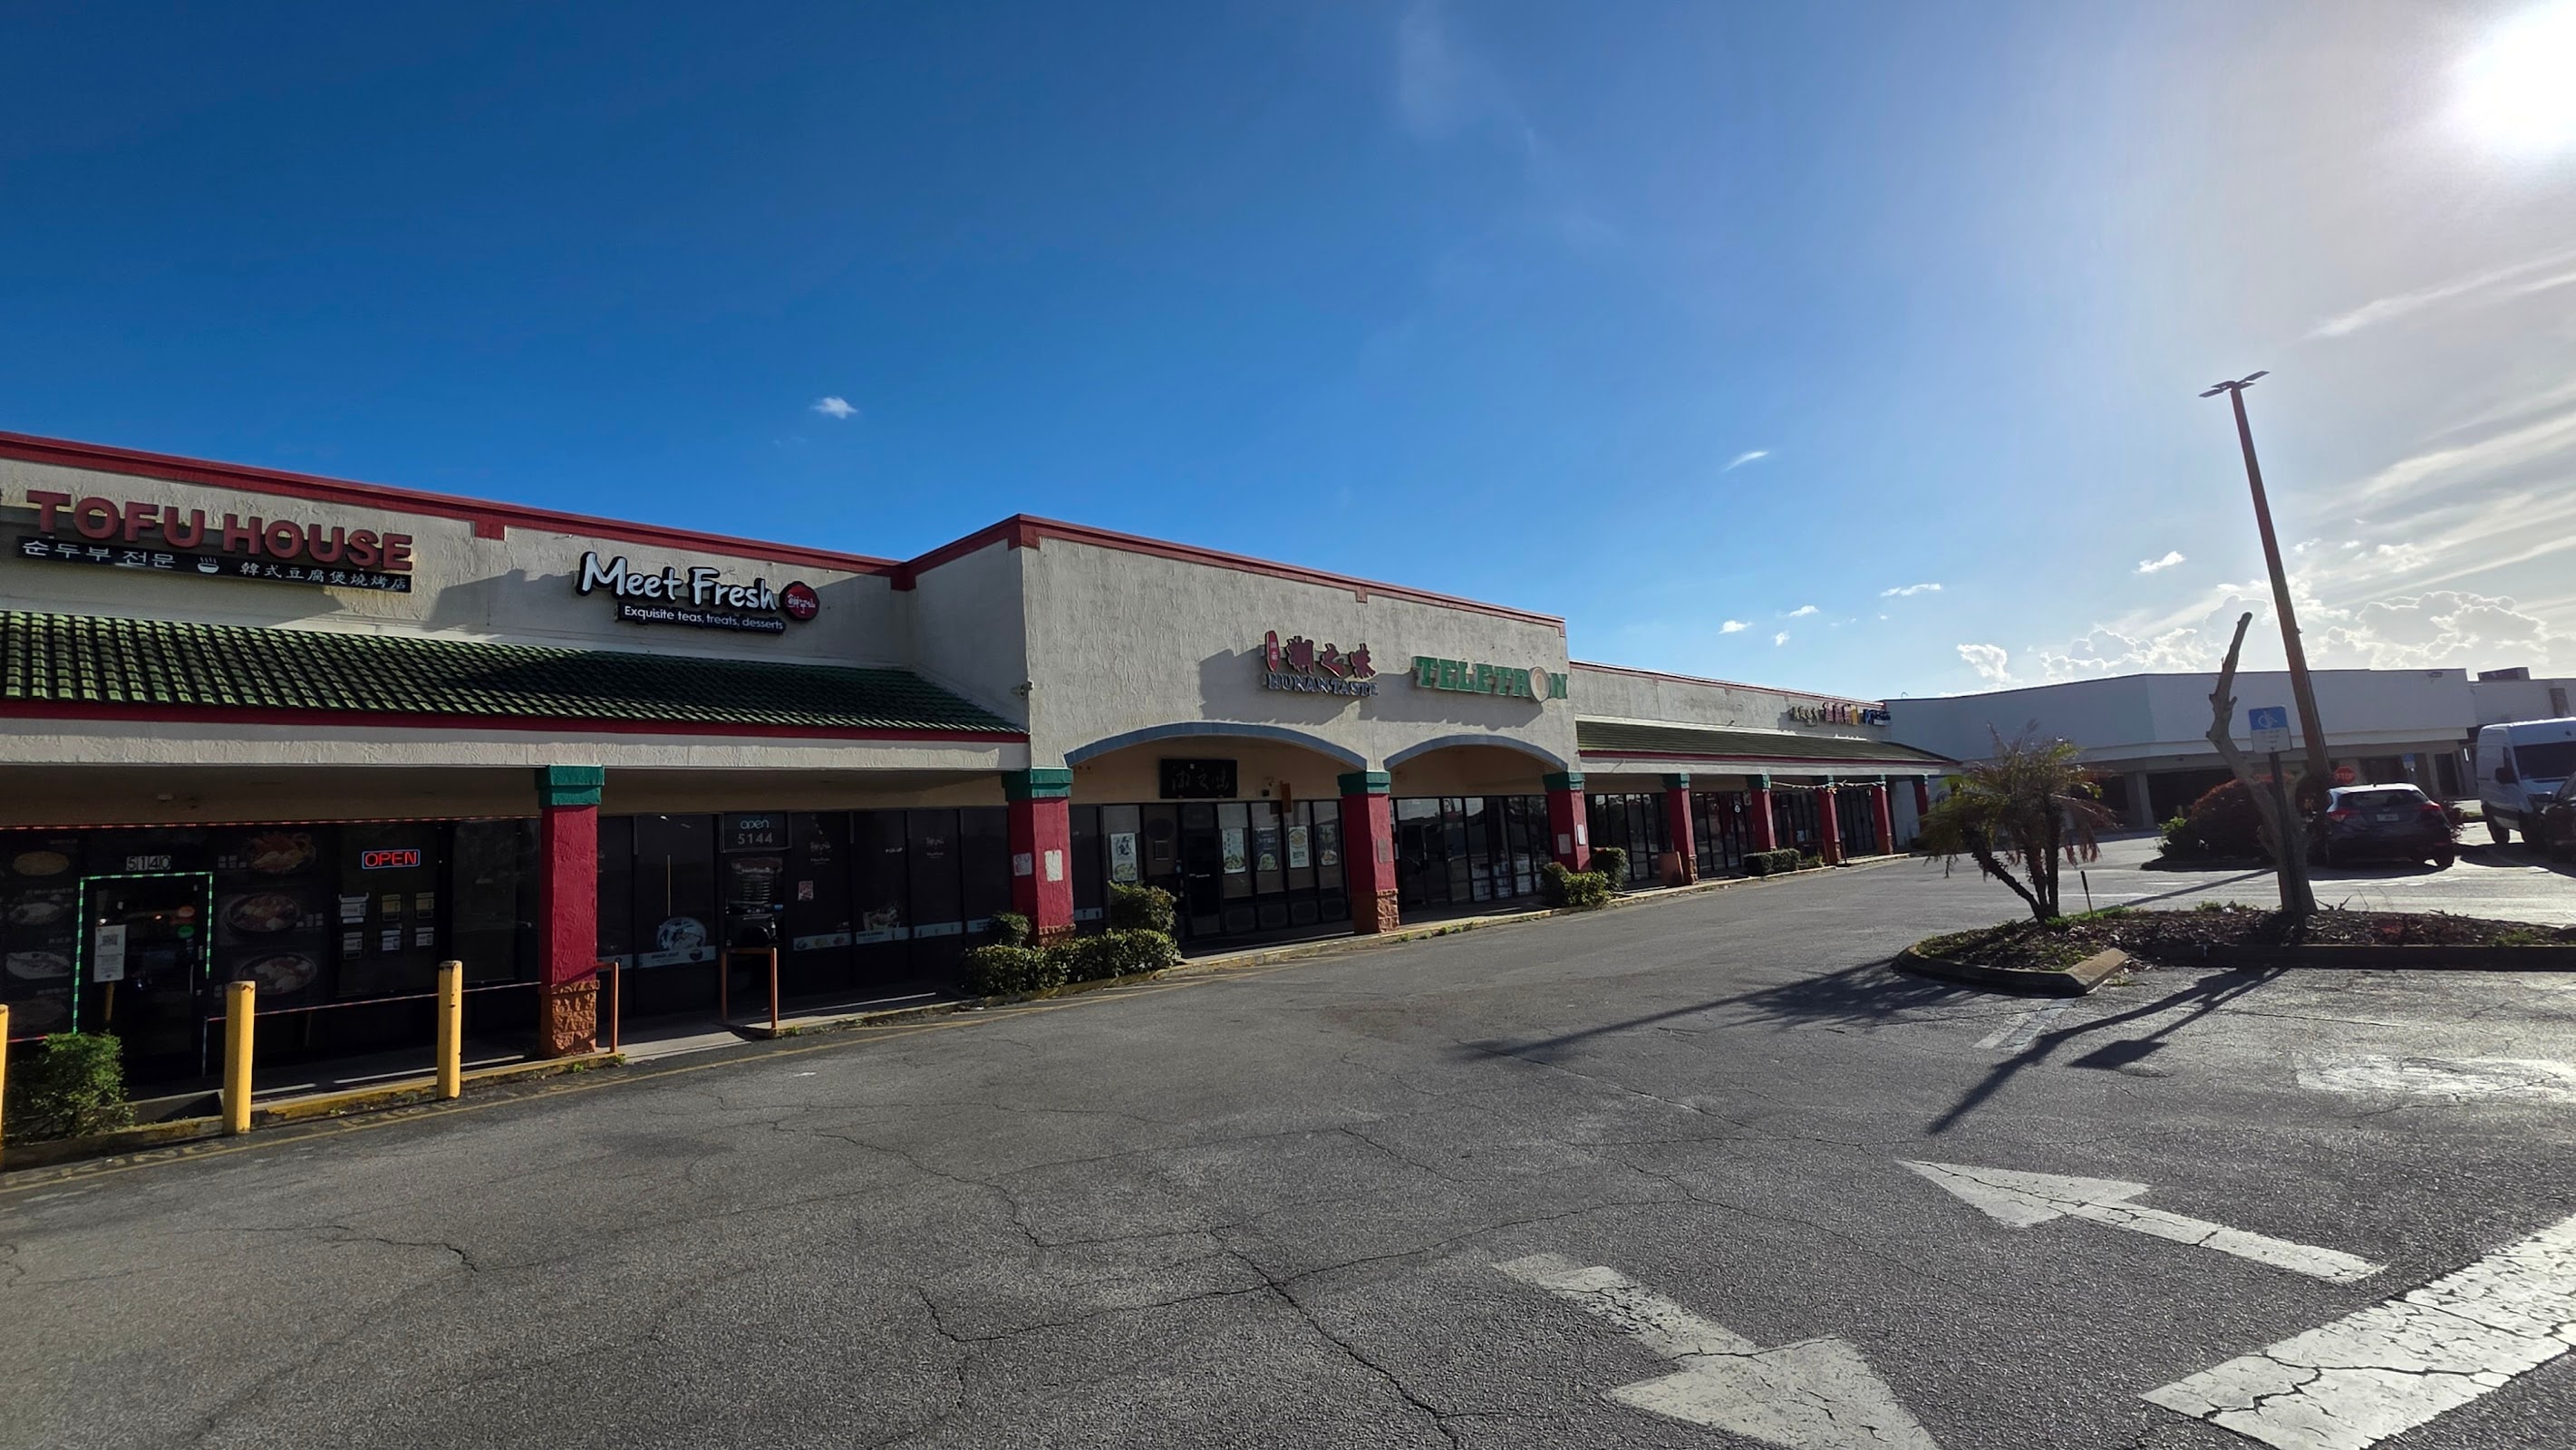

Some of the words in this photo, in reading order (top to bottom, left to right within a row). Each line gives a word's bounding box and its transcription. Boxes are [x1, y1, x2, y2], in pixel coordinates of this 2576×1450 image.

[27, 490, 205, 548] TOFU
[223, 513, 412, 570] HOUSE
[23, 540, 111, 561] 순두부
[122, 550, 176, 568] 전문
[239, 562, 407, 589] 韓式豆腐煲燒烤店
[579, 552, 682, 600] Meet
[690, 567, 777, 611] Fresh
[625, 605, 674, 621] Exquisite
[678, 611, 704, 624] teas,
[706, 614, 740, 627] treats,
[742, 616, 783, 631] desserts
[1266, 673, 1329, 693] HUNAN
[1331, 678, 1379, 696] TASTE
[1412, 656, 1568, 703] TELETRON
[2334, 771, 2355, 780] STOP
[740, 819, 770, 829] open
[738, 833, 773, 845] 5144
[126, 856, 171, 870] 5140
[365, 852, 419, 867] OPEN
